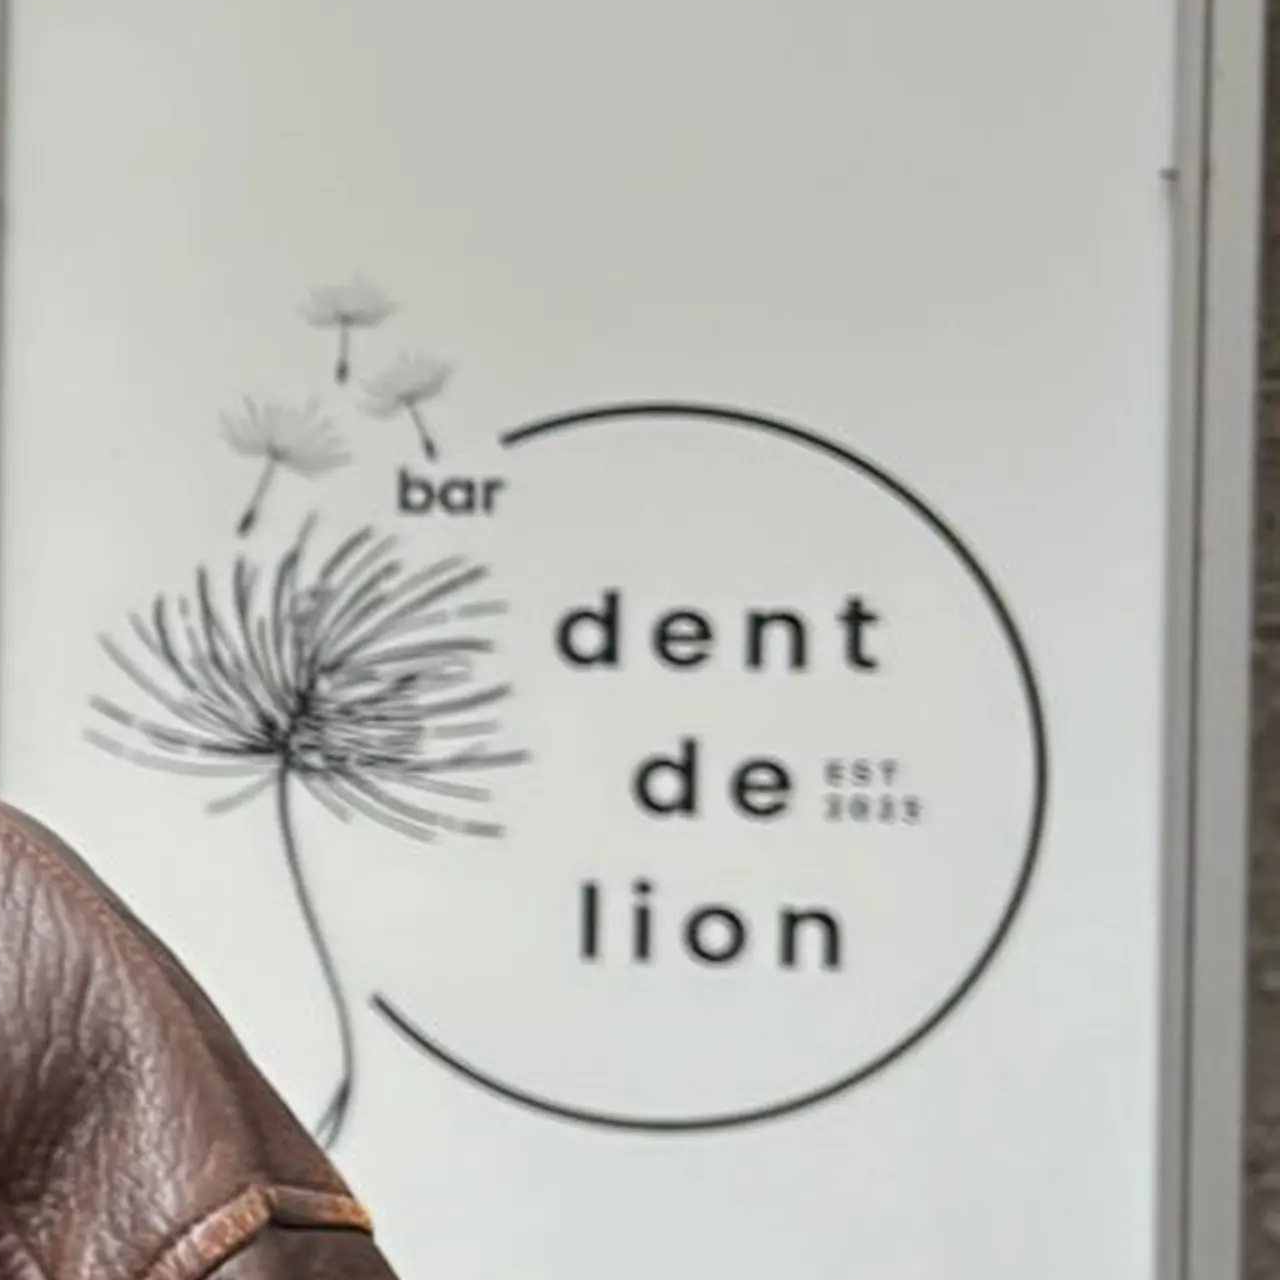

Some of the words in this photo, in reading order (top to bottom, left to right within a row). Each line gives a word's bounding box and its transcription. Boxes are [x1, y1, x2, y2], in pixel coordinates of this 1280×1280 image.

[397, 469, 506, 515] bar
[553, 587, 881, 674] dent
[632, 736, 794, 820] de
[579, 877, 843, 973] lion
